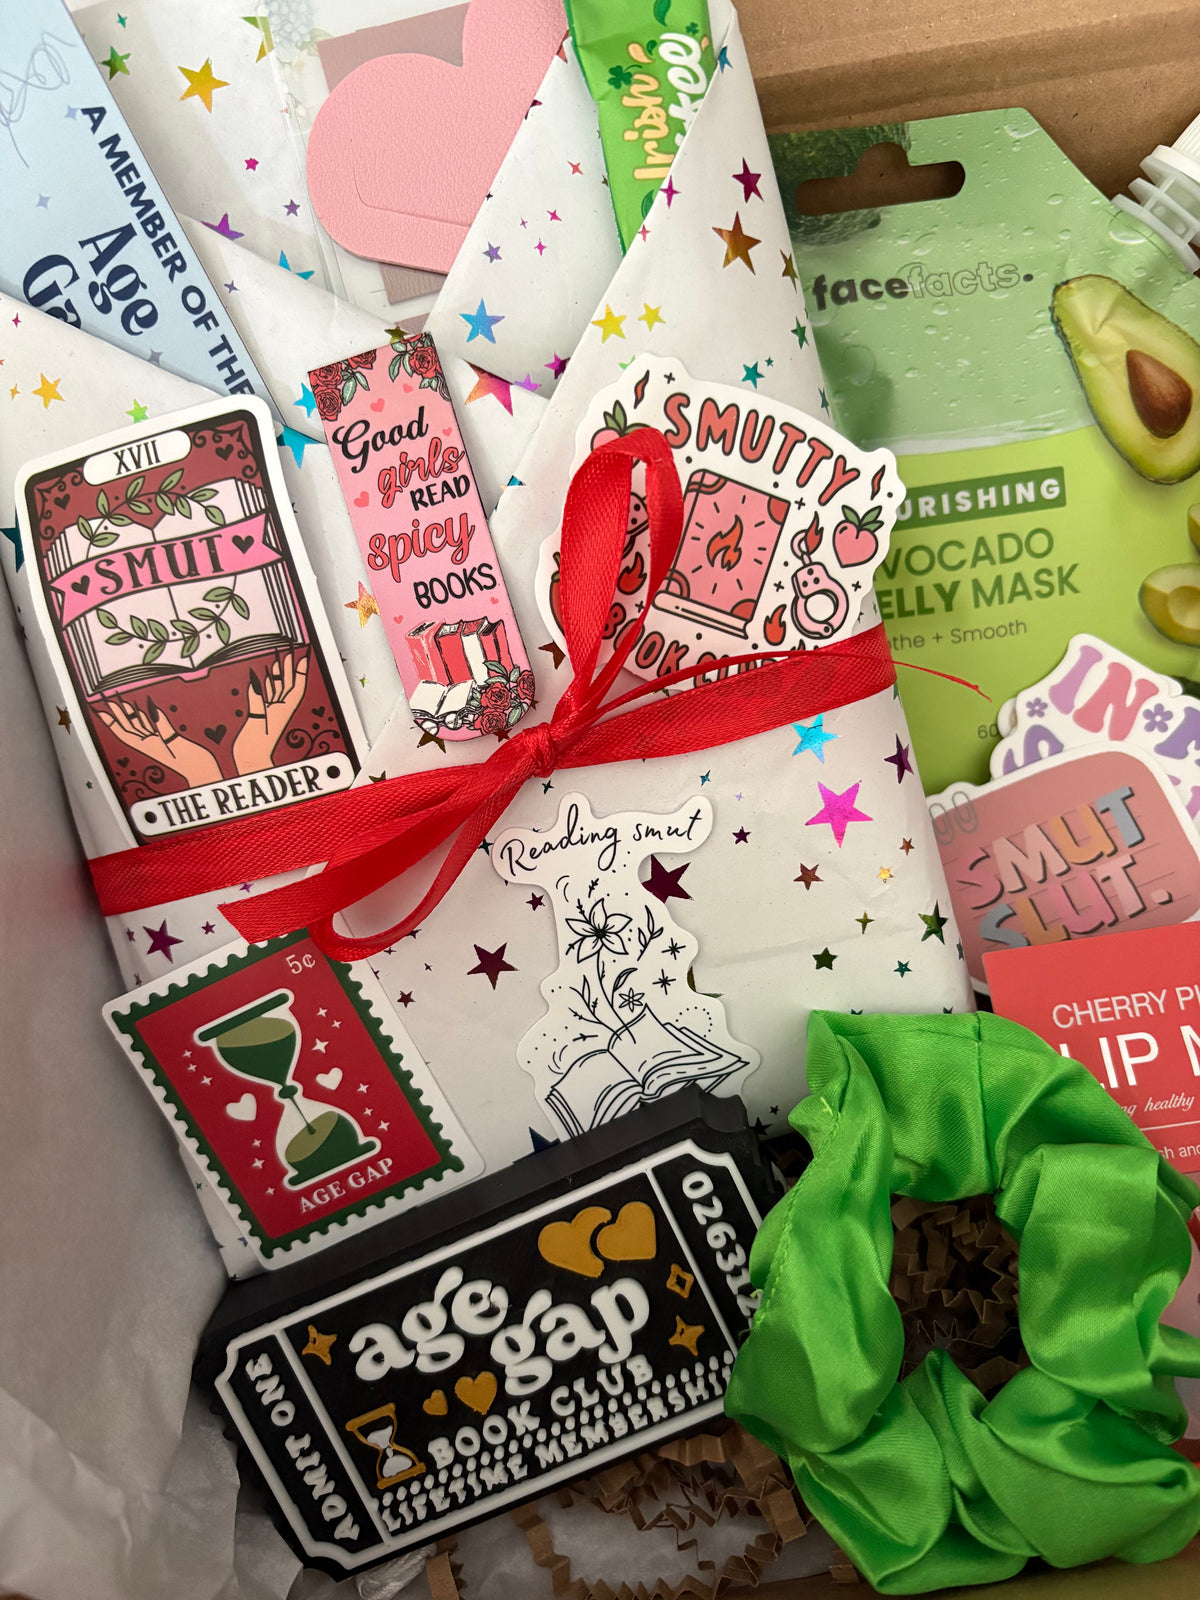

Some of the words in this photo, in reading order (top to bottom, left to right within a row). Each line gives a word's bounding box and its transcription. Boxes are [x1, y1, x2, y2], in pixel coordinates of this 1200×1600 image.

[621, 73, 675, 180] Irish
[80, 106, 107, 135] A
[98, 133, 188, 283] MEMBER
[181, 284, 220, 332] OF
[78, 222, 159, 336] Age
[114, 440, 161, 476] XVII
[332, 405, 429, 474] Good
[377, 436, 465, 509] girls
[664, 392, 861, 506] SMUTTY
[410, 474, 471, 512] READ
[897, 478, 1061, 521] URISHING
[94, 534, 225, 597] SMUT
[414, 562, 497, 610] BOOKS
[874, 528, 1054, 581] VOCADO
[876, 581, 961, 620] ELLY
[971, 563, 1080, 609] MASK
[951, 619, 1027, 644] Smooth
[159, 793, 210, 828] THE
[218, 765, 323, 816] READER
[500, 803, 621, 876] Reading
[632, 808, 703, 841] smut
[955, 786, 1145, 911] SMUT
[286, 953, 316, 975] 5¢
[1052, 989, 1167, 1029] CHERRY
[1144, 1092, 1195, 1113] healthy
[299, 1180, 347, 1213] AGE
[347, 1157, 395, 1190] GAP
[682, 1170, 763, 1328] 026312
[348, 1265, 508, 1381] age
[490, 1277, 650, 1396] gap
[245, 1352, 296, 1426] ONE
[427, 1400, 541, 1470] BOOK
[550, 1354, 653, 1417] CLUB
[285, 1433, 360, 1541] ADMIT
[381, 1453, 528, 1532] LIFETIME
